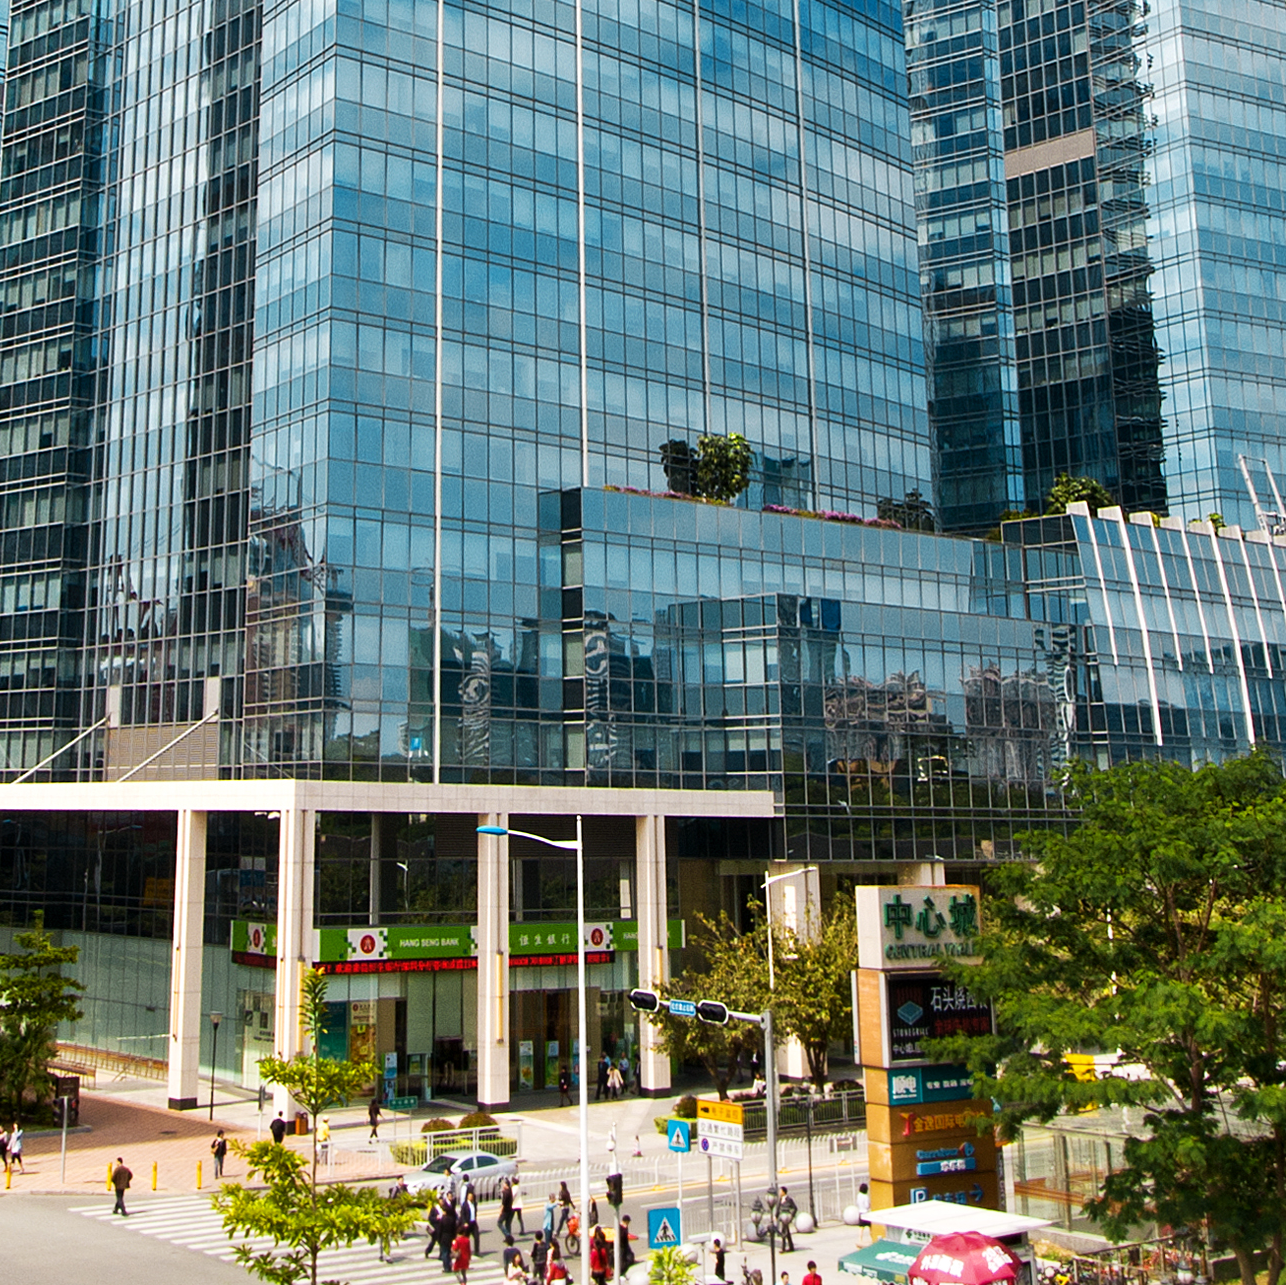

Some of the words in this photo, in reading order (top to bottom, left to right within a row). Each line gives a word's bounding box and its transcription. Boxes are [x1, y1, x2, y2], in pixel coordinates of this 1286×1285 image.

[883, 894, 979, 939] 中心城
[399, 939, 420, 948] HANG
[421, 938, 439, 947] SENG
[441, 937, 460, 947] BANK
[884, 943, 941, 959] CENTRAL
[930, 985, 988, 1012] 石头烧西
[915, 1190, 927, 1203] P
